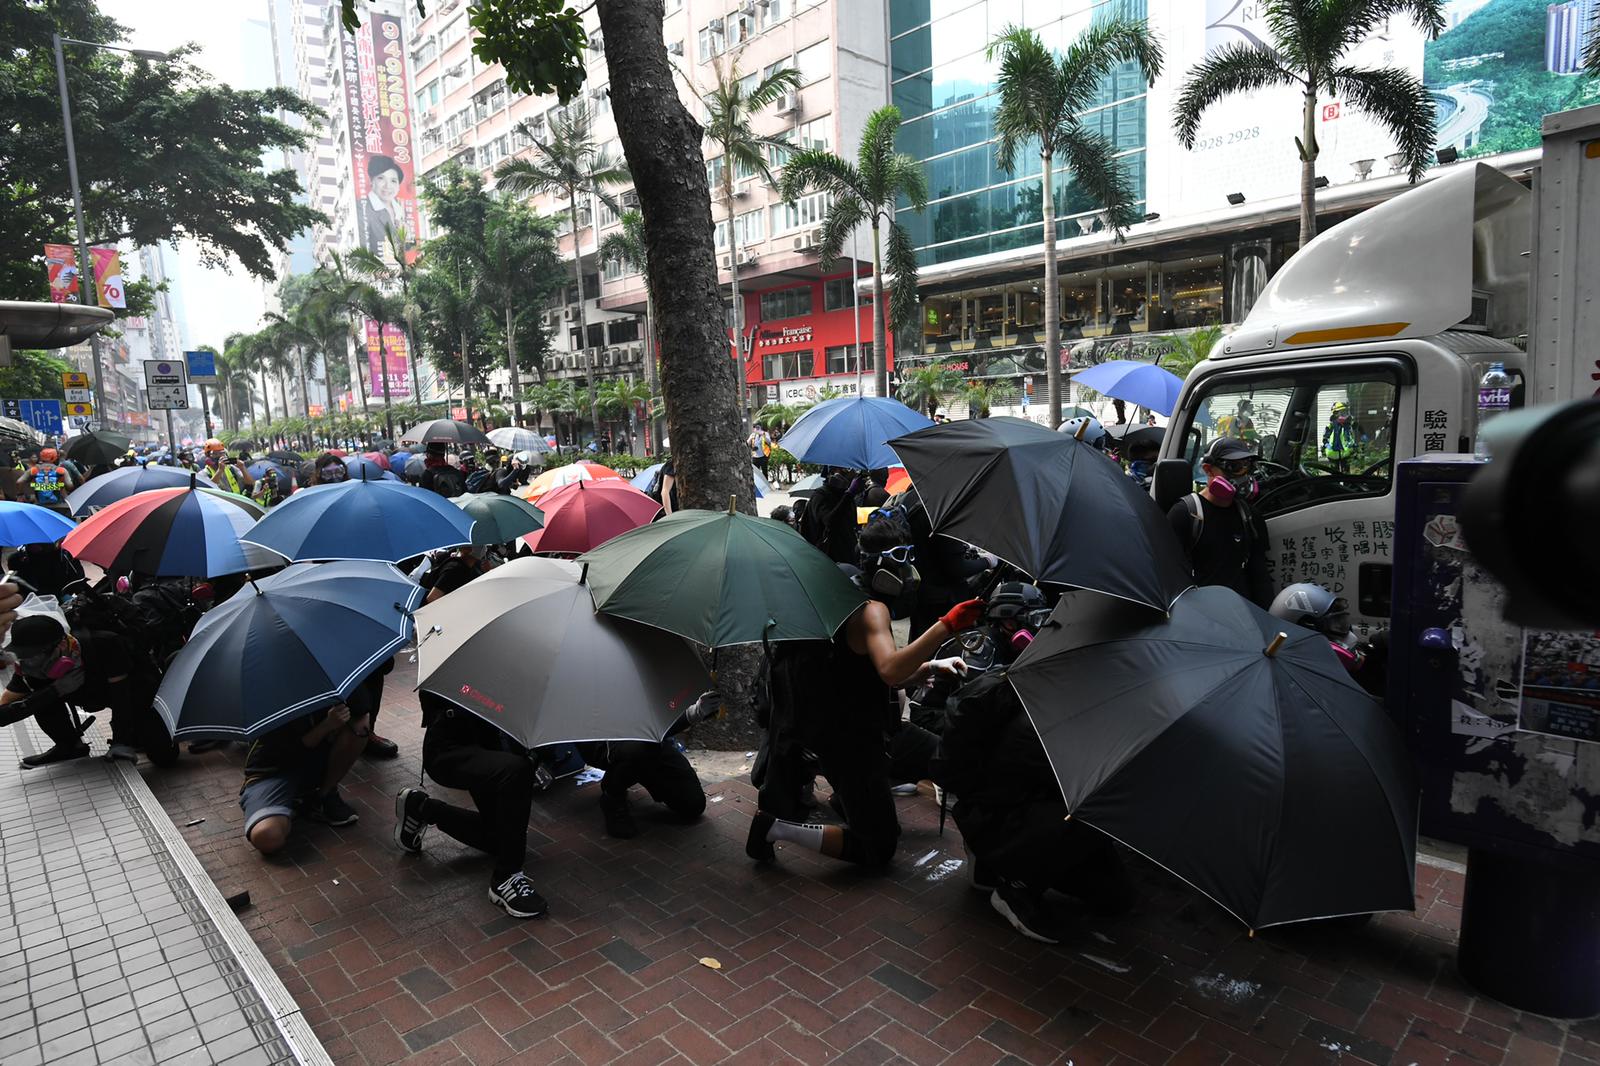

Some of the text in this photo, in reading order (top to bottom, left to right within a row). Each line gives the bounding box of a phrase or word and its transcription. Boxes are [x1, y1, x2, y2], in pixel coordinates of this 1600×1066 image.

[382, 21, 411, 164] 94928003
[1227, 126, 1260, 145] 2928
[103, 284, 120, 299] 70
[783, 324, 812, 336] Française
[786, 388, 803, 398] ICBC
[174, 400, 186, 408] 12
[35, 482, 60, 490] PRESS
